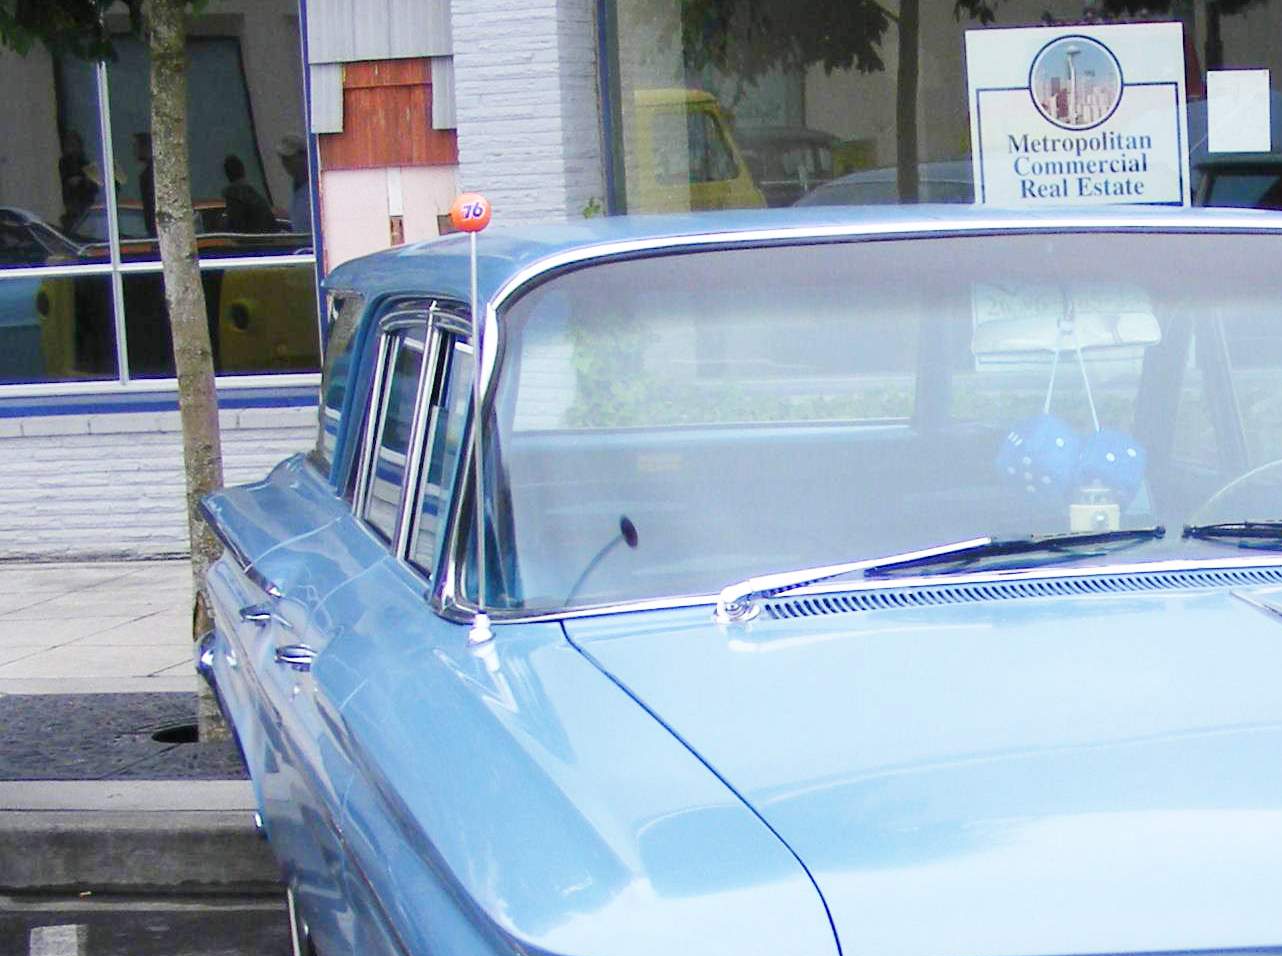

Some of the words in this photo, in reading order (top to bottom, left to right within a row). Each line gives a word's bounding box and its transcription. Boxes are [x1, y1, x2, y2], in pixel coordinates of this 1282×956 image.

[1007, 130, 1152, 157] Metropolitan
[1013, 152, 1149, 177] Commercial
[1020, 177, 1069, 199] Real
[1077, 176, 1145, 198] Estate
[463, 201, 484, 219] 76
